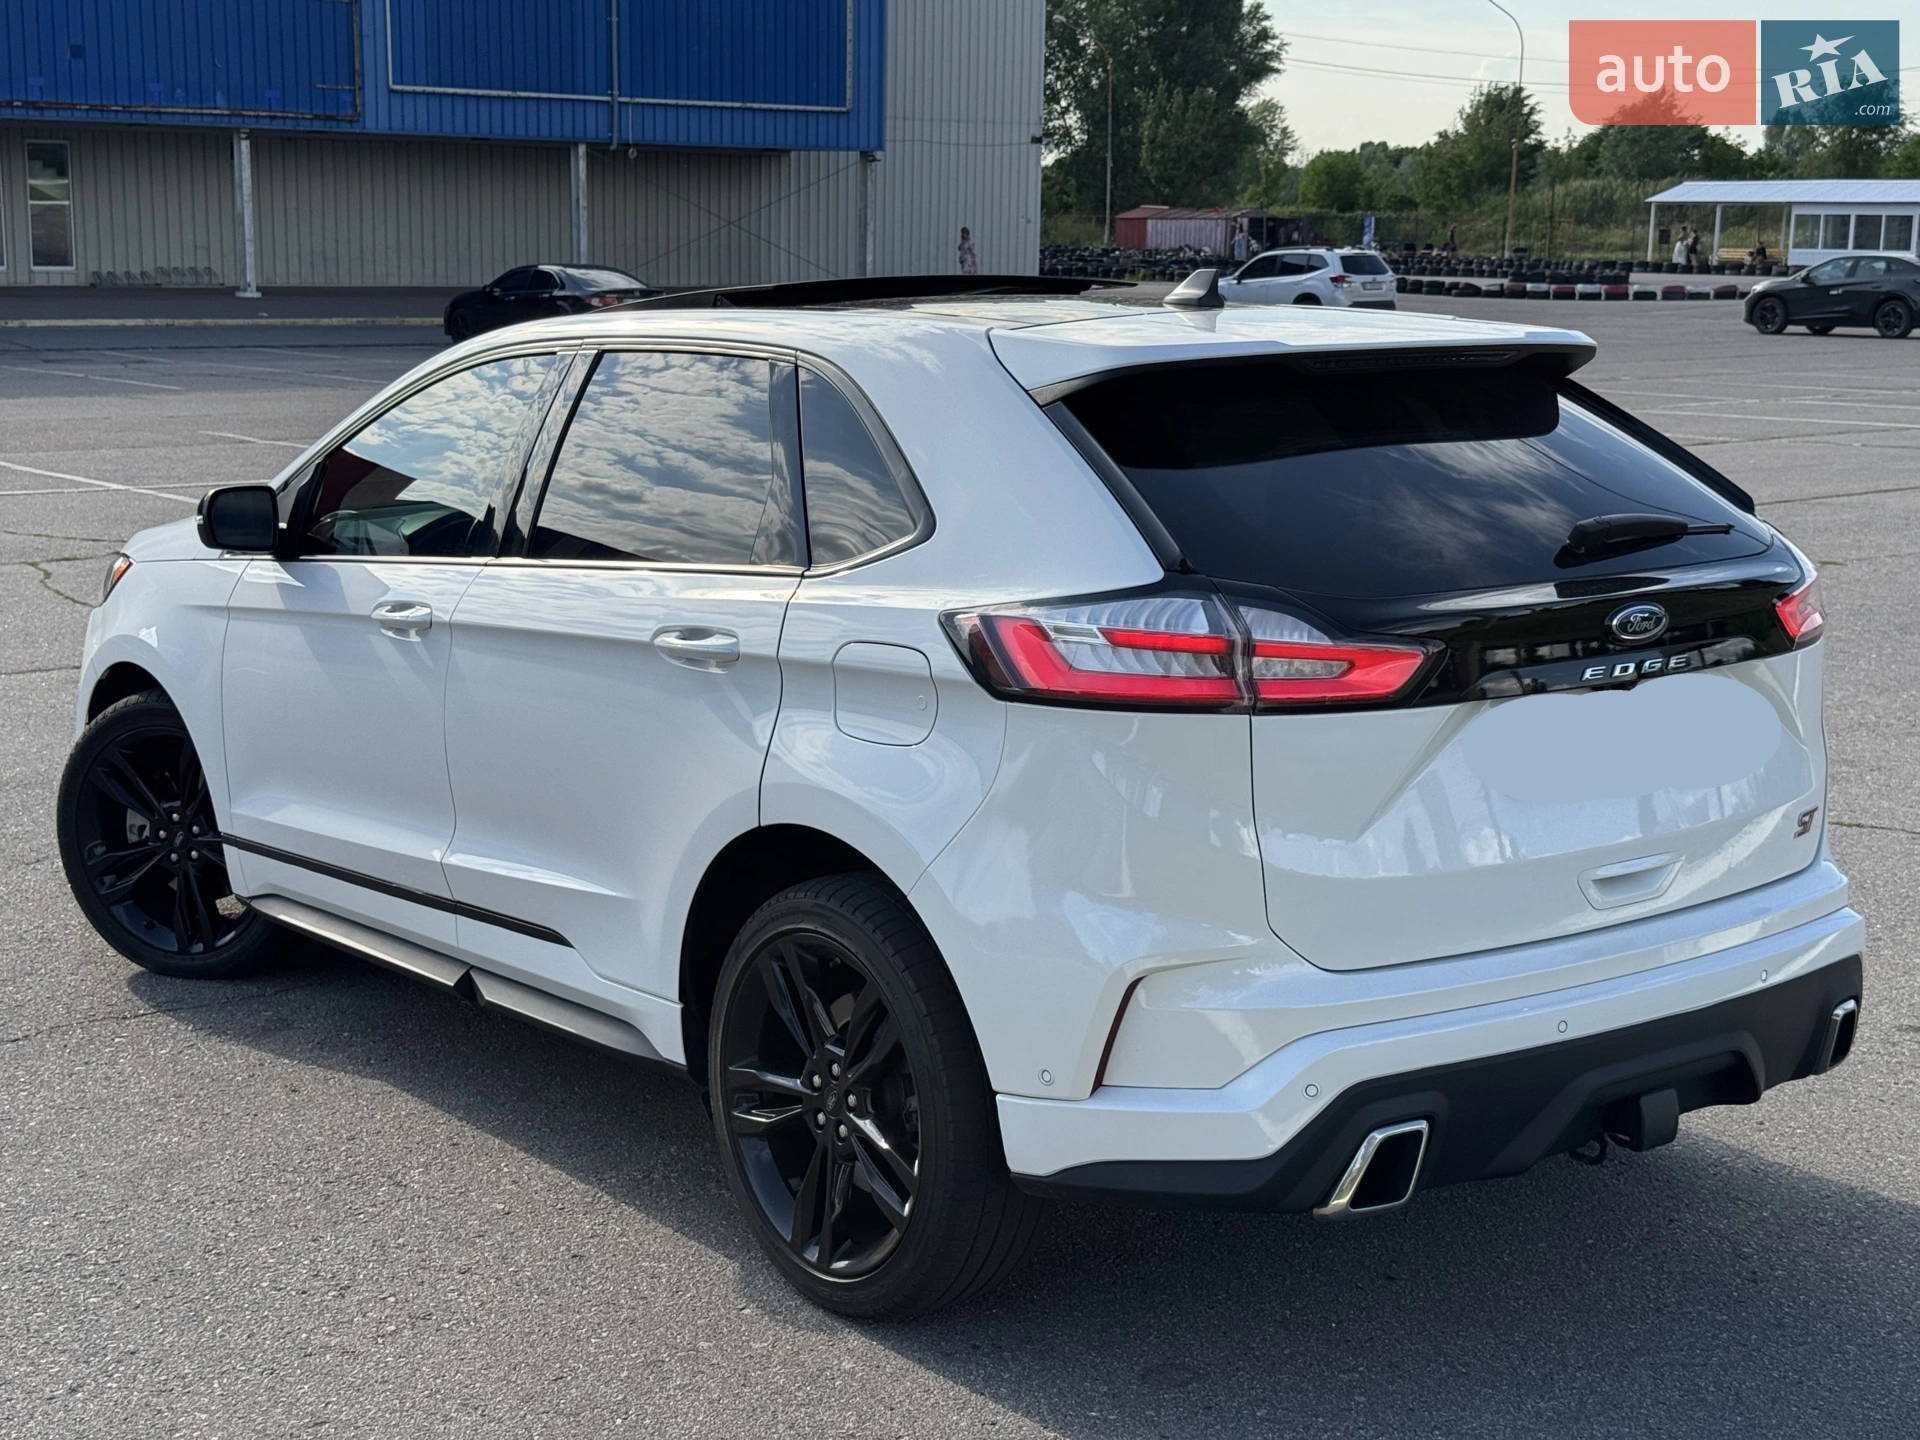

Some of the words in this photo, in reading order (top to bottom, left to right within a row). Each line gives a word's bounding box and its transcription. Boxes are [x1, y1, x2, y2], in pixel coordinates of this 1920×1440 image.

[1627, 613, 1656, 633] Ford
[1581, 654, 1689, 681] EDGE
[1793, 804, 1819, 839] ST
